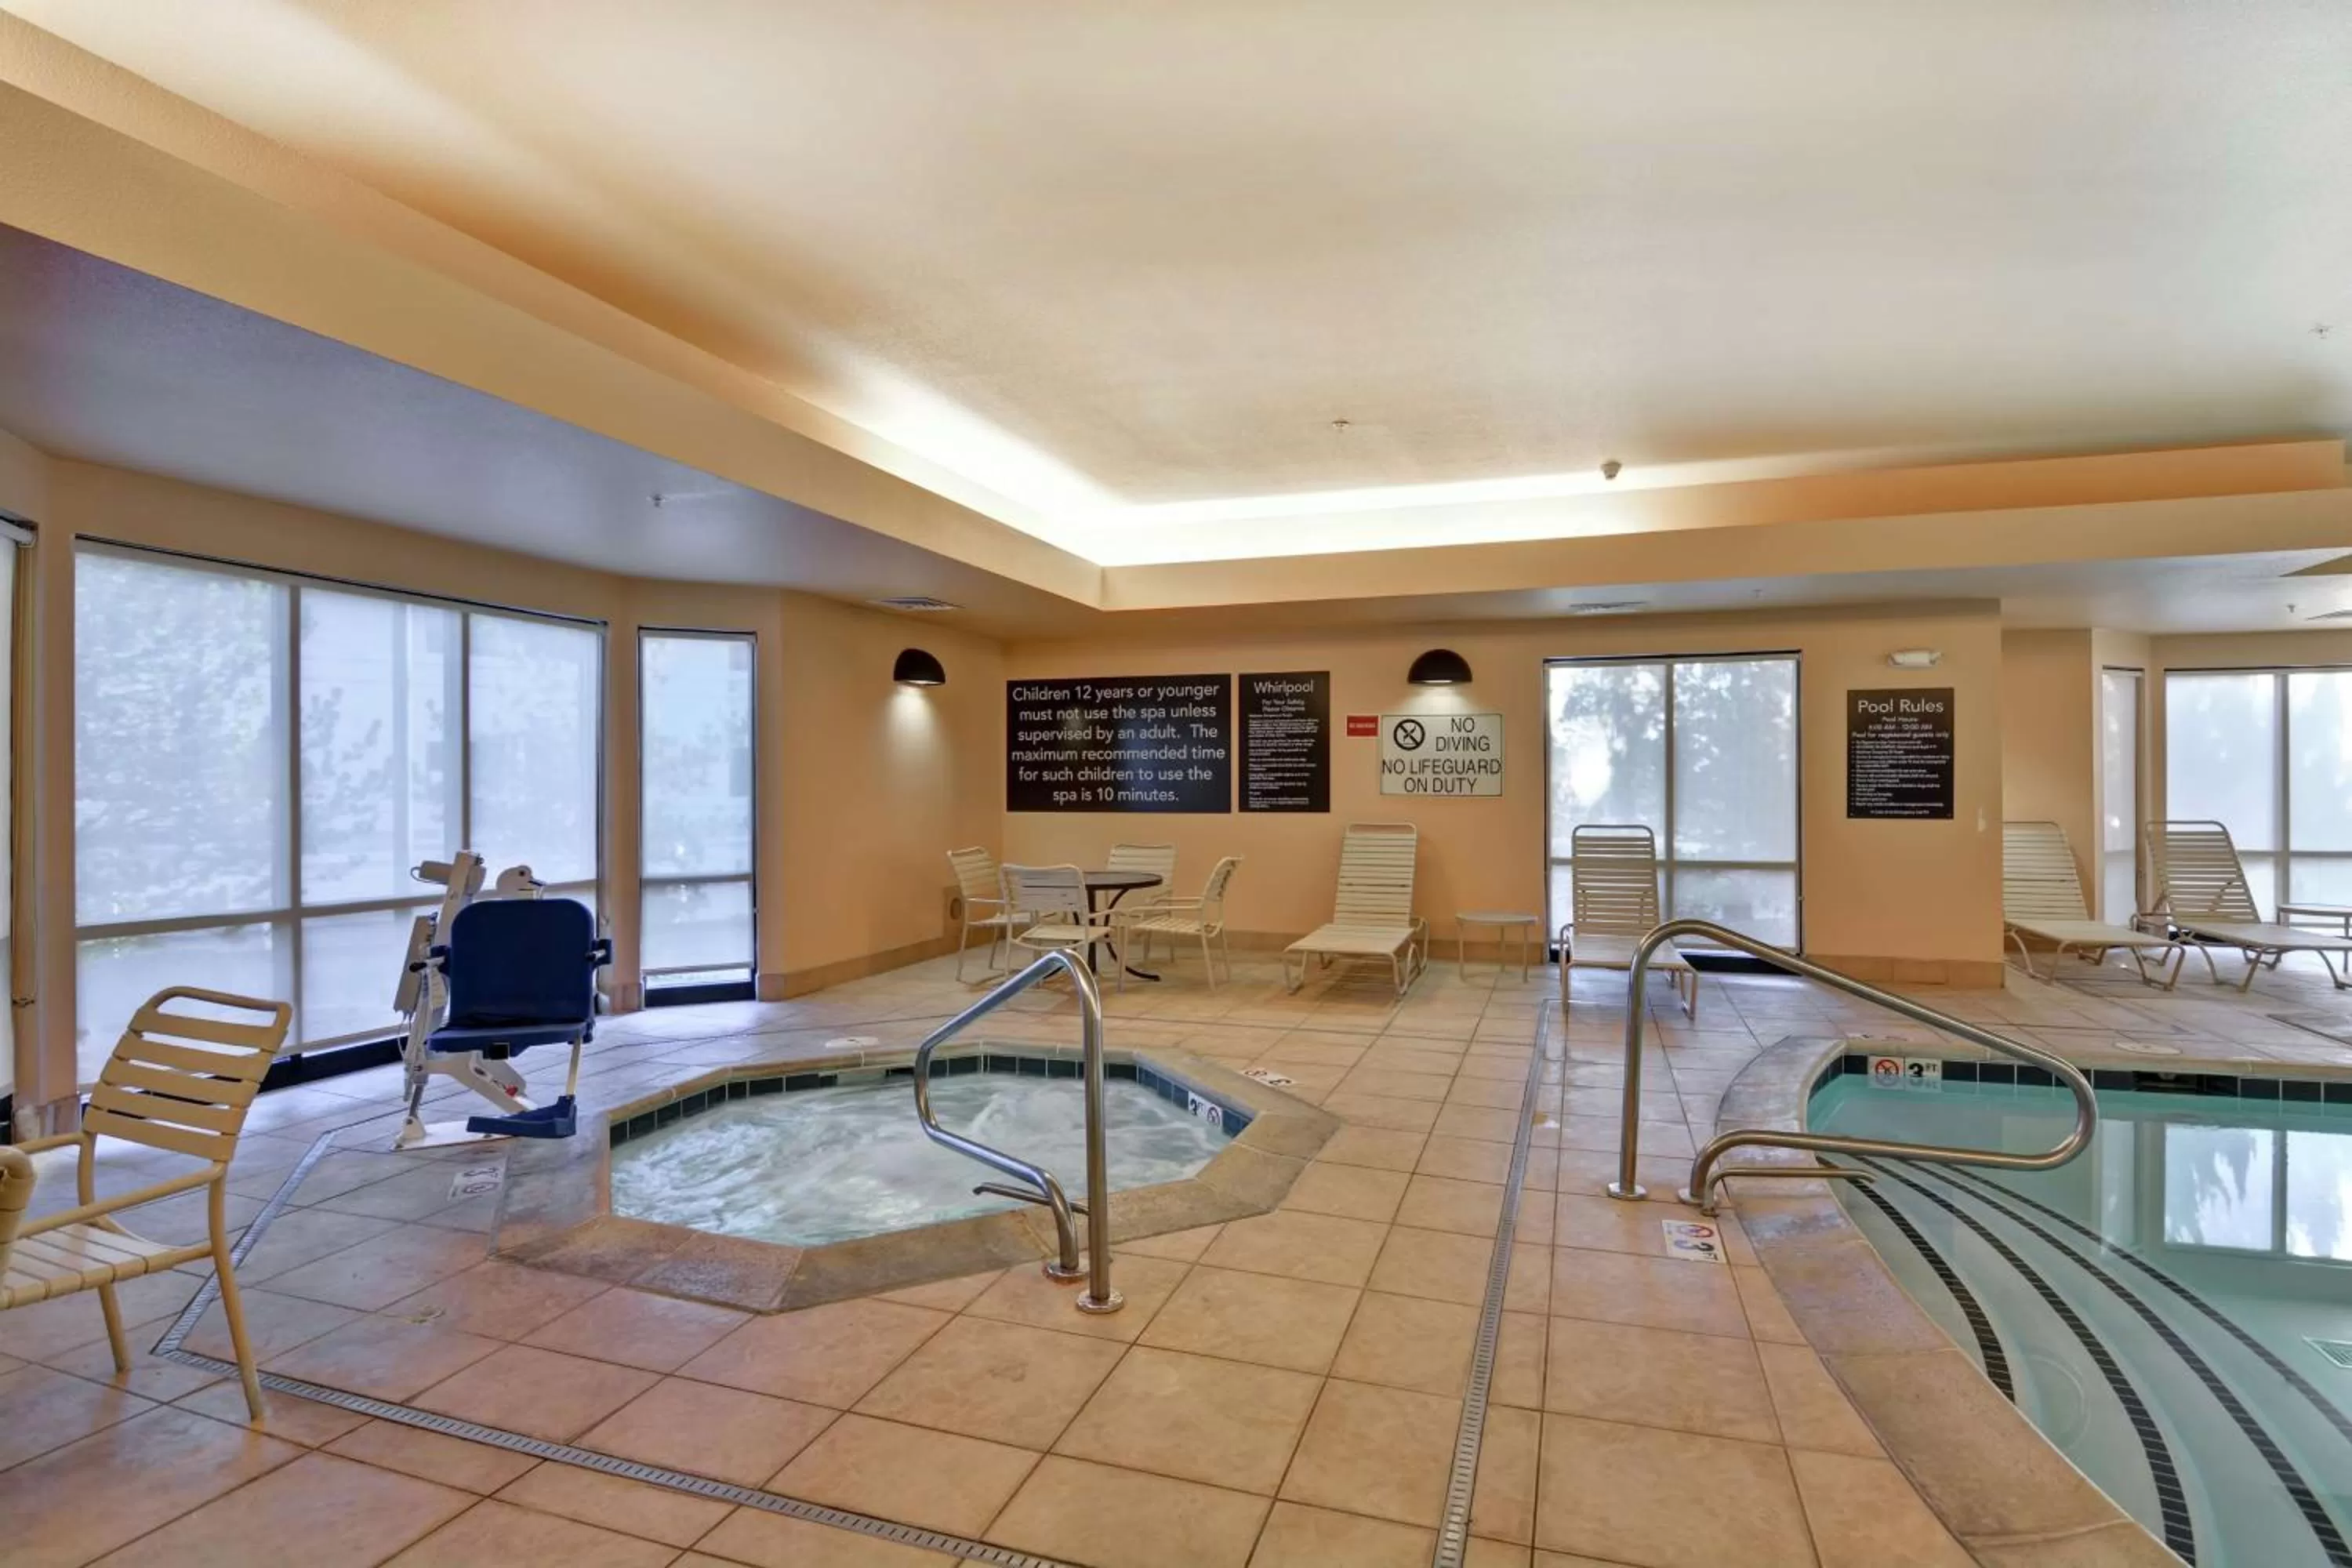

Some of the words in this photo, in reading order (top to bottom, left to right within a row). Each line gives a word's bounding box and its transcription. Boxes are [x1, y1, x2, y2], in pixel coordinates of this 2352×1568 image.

[1012, 685, 1070, 702] Children
[1075, 685, 1092, 699] 12
[1095, 688, 1134, 702] years
[1138, 688, 1152, 698] or
[1157, 684, 1220, 701] younger
[1254, 678, 1314, 696] Whirlpool
[1019, 708, 1053, 720] must
[1057, 706, 1079, 719] not
[1084, 709, 1108, 719] use
[1112, 704, 1136, 719] the
[1140, 707, 1166, 723] spa
[1171, 702, 1217, 717] unless
[1857, 698, 1893, 713] Pool
[1900, 698, 1944, 713] Rules
[1451, 717, 1475, 732] NO
[1018, 726, 1092, 745] supervised
[1096, 724, 1114, 744] by
[1117, 728, 1134, 739] an
[1139, 724, 1181, 739] adult.
[1189, 724, 1218, 739] The
[1436, 736, 1490, 751] DIVING
[1011, 746, 1078, 761] maximum
[1082, 745, 1187, 761] recommended
[1191, 746, 1225, 760] time
[1019, 767, 1038, 781] for
[1042, 766, 1073, 781] such
[1077, 766, 1134, 781] children
[1138, 768, 1153, 780] to
[1158, 770, 1183, 780] use
[1188, 765, 1212, 780] the
[1382, 758, 1406, 774] NO
[1409, 758, 1502, 774] LIFEGUARD
[1404, 777, 1427, 793] ON
[1432, 777, 1477, 793] DUTY
[1053, 790, 1076, 806] spa
[1081, 788, 1092, 800] is
[1097, 786, 1114, 801] 10
[1117, 786, 1179, 801] minutes.
[1674, 1240, 1715, 1252] 3
